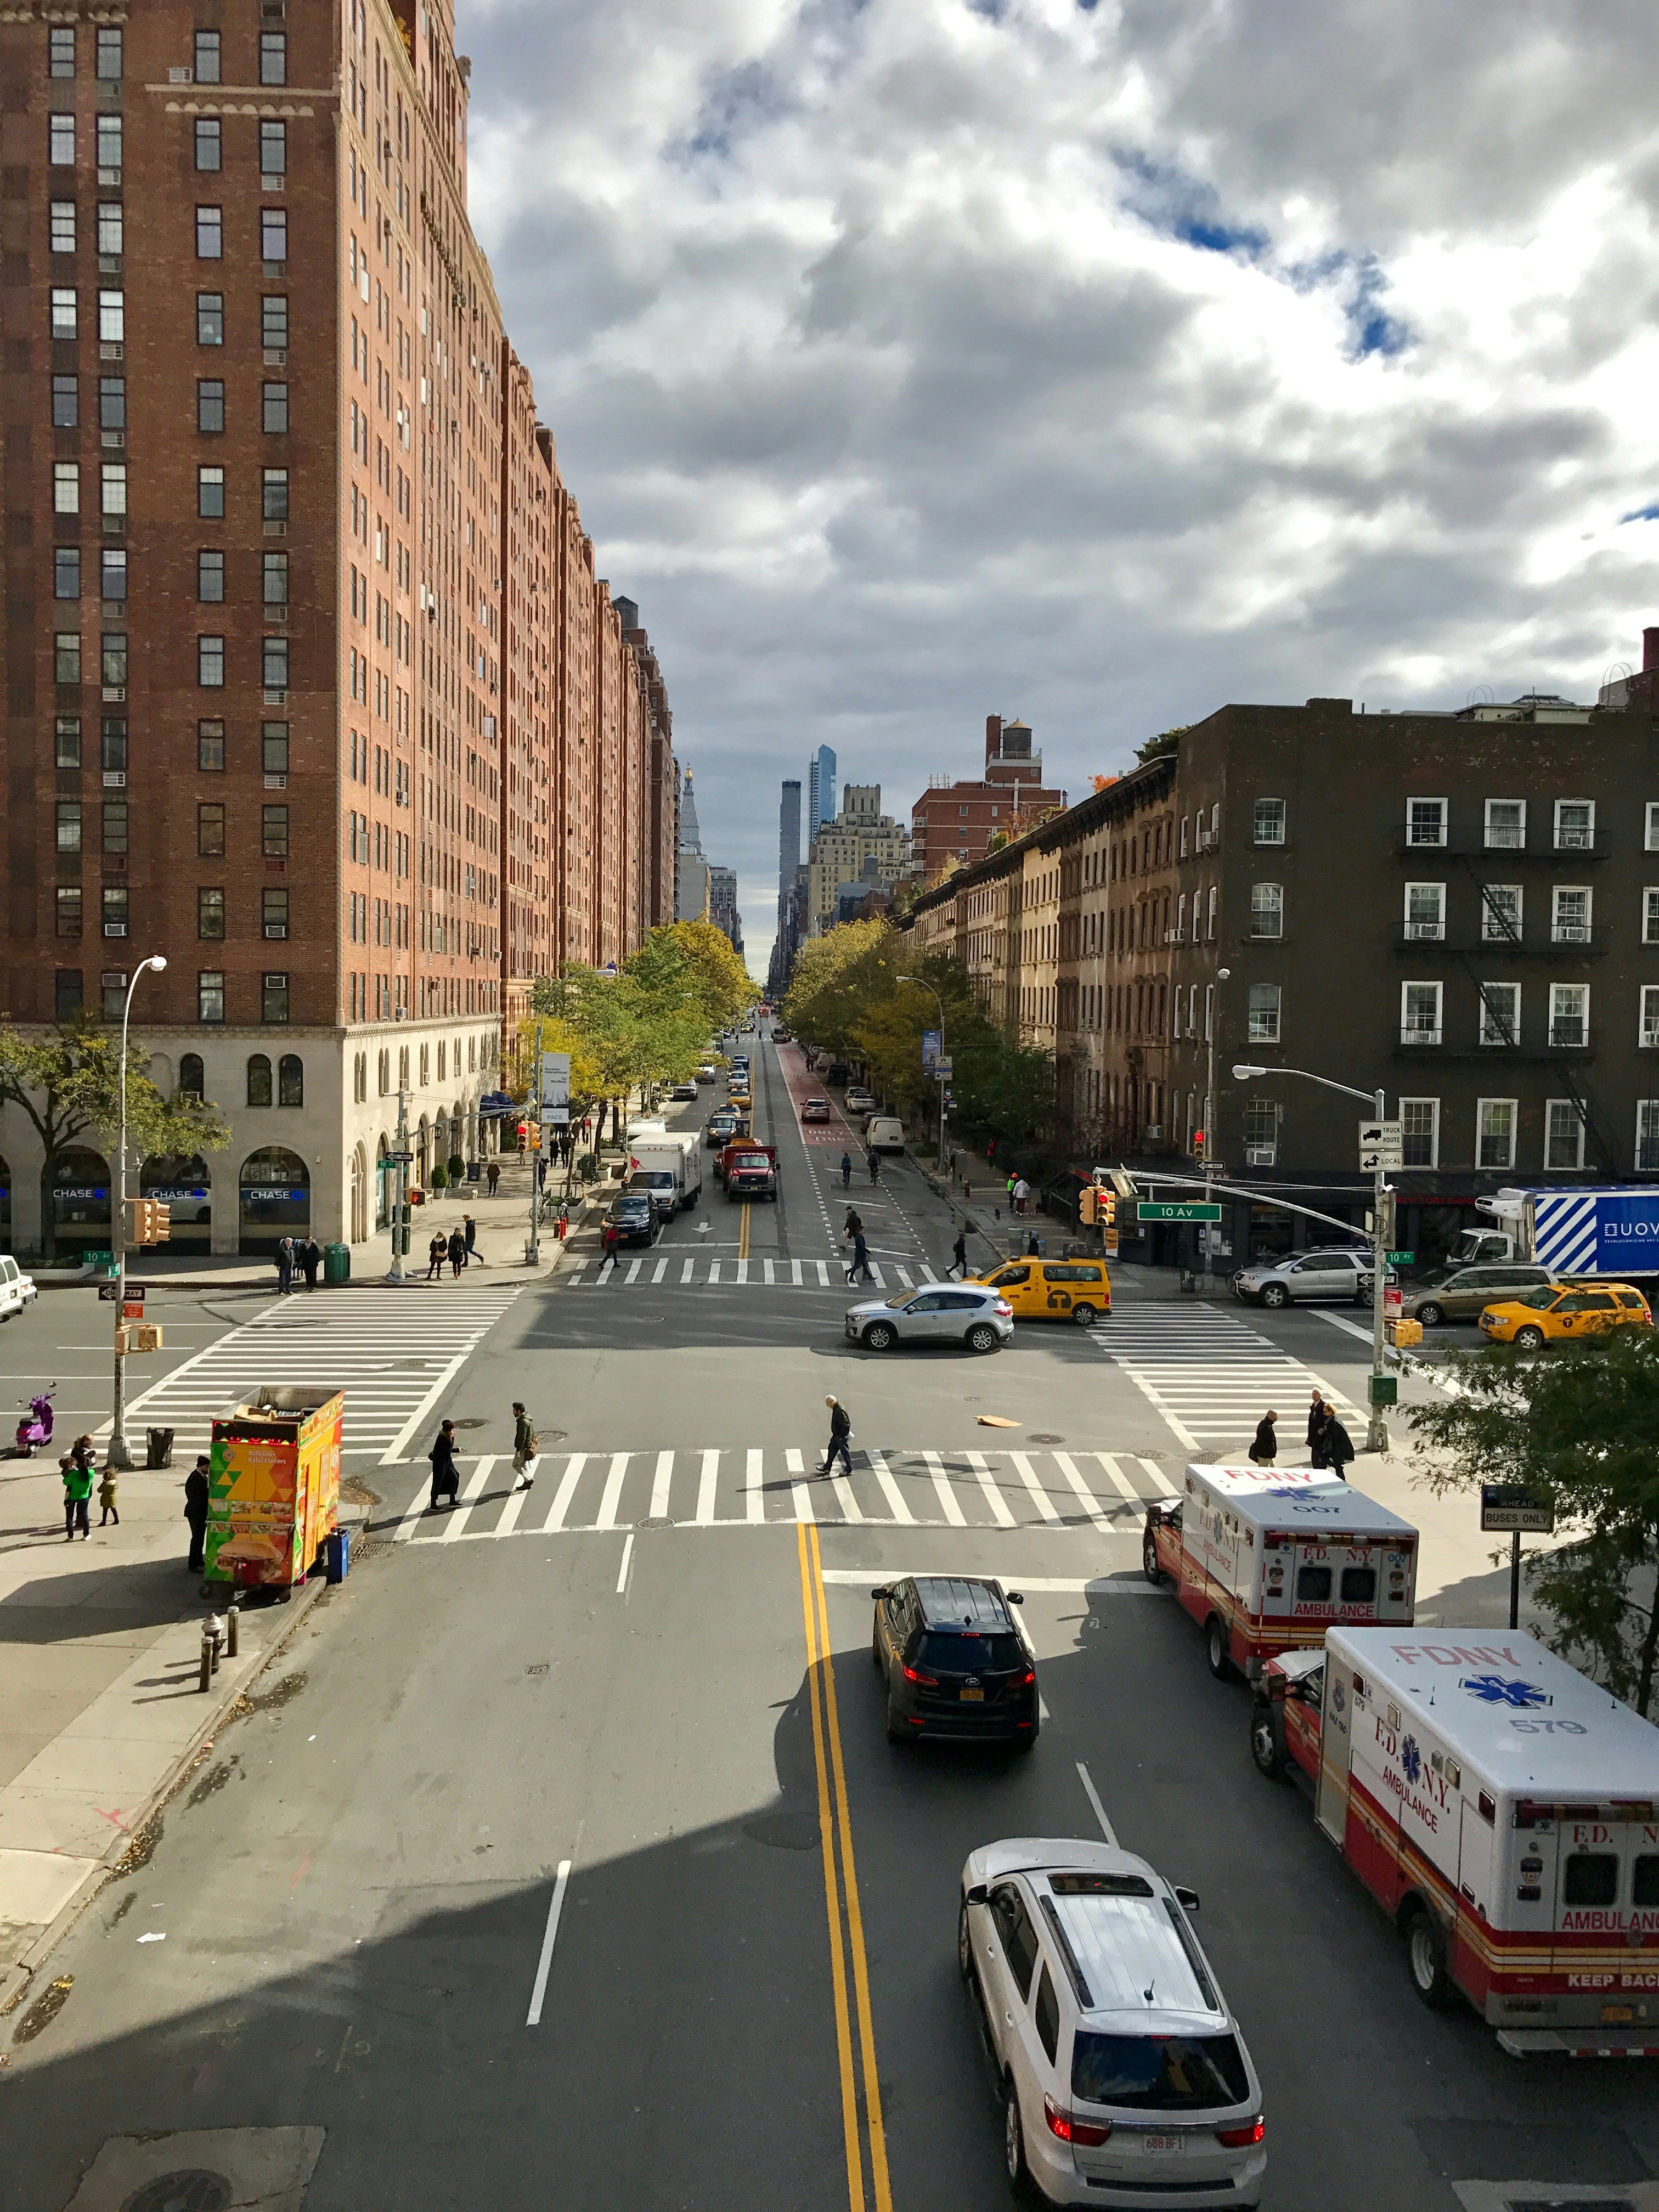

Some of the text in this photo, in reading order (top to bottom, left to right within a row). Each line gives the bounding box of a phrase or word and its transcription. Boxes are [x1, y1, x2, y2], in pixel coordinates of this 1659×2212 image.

[53, 1189, 92, 1198] CHASE
[152, 1190, 191, 1199] CHASE
[251, 1191, 290, 1199] CHASE
[1161, 1207, 1193, 1217] 10 Av
[88, 1252, 98, 1262] 10
[1390, 1254, 1400, 1262] 10
[1223, 1470, 1313, 1483] FDNY
[1502, 1499, 1534, 1508] AHEAD
[1486, 1513, 1548, 1523] BUSES ONLY
[1203, 1538, 1231, 1573] AMBULANCE
[1304, 1547, 1373, 1562] F.D. N.Y.
[1387, 1554, 1407, 1563] 007
[1294, 1603, 1374, 1617] AMBULANCE
[1390, 1645, 1521, 1667] FDNY
[1354, 1697, 1365, 1712] 579
[1509, 1719, 1588, 1735] 579
[1375, 1716, 1450, 1814] F.D. N.Y.
[1383, 1765, 1438, 1834] AMBULANCE
[1573, 1825, 1613, 1844] F.D.
[1568, 1974, 1615, 1987] KEEP
